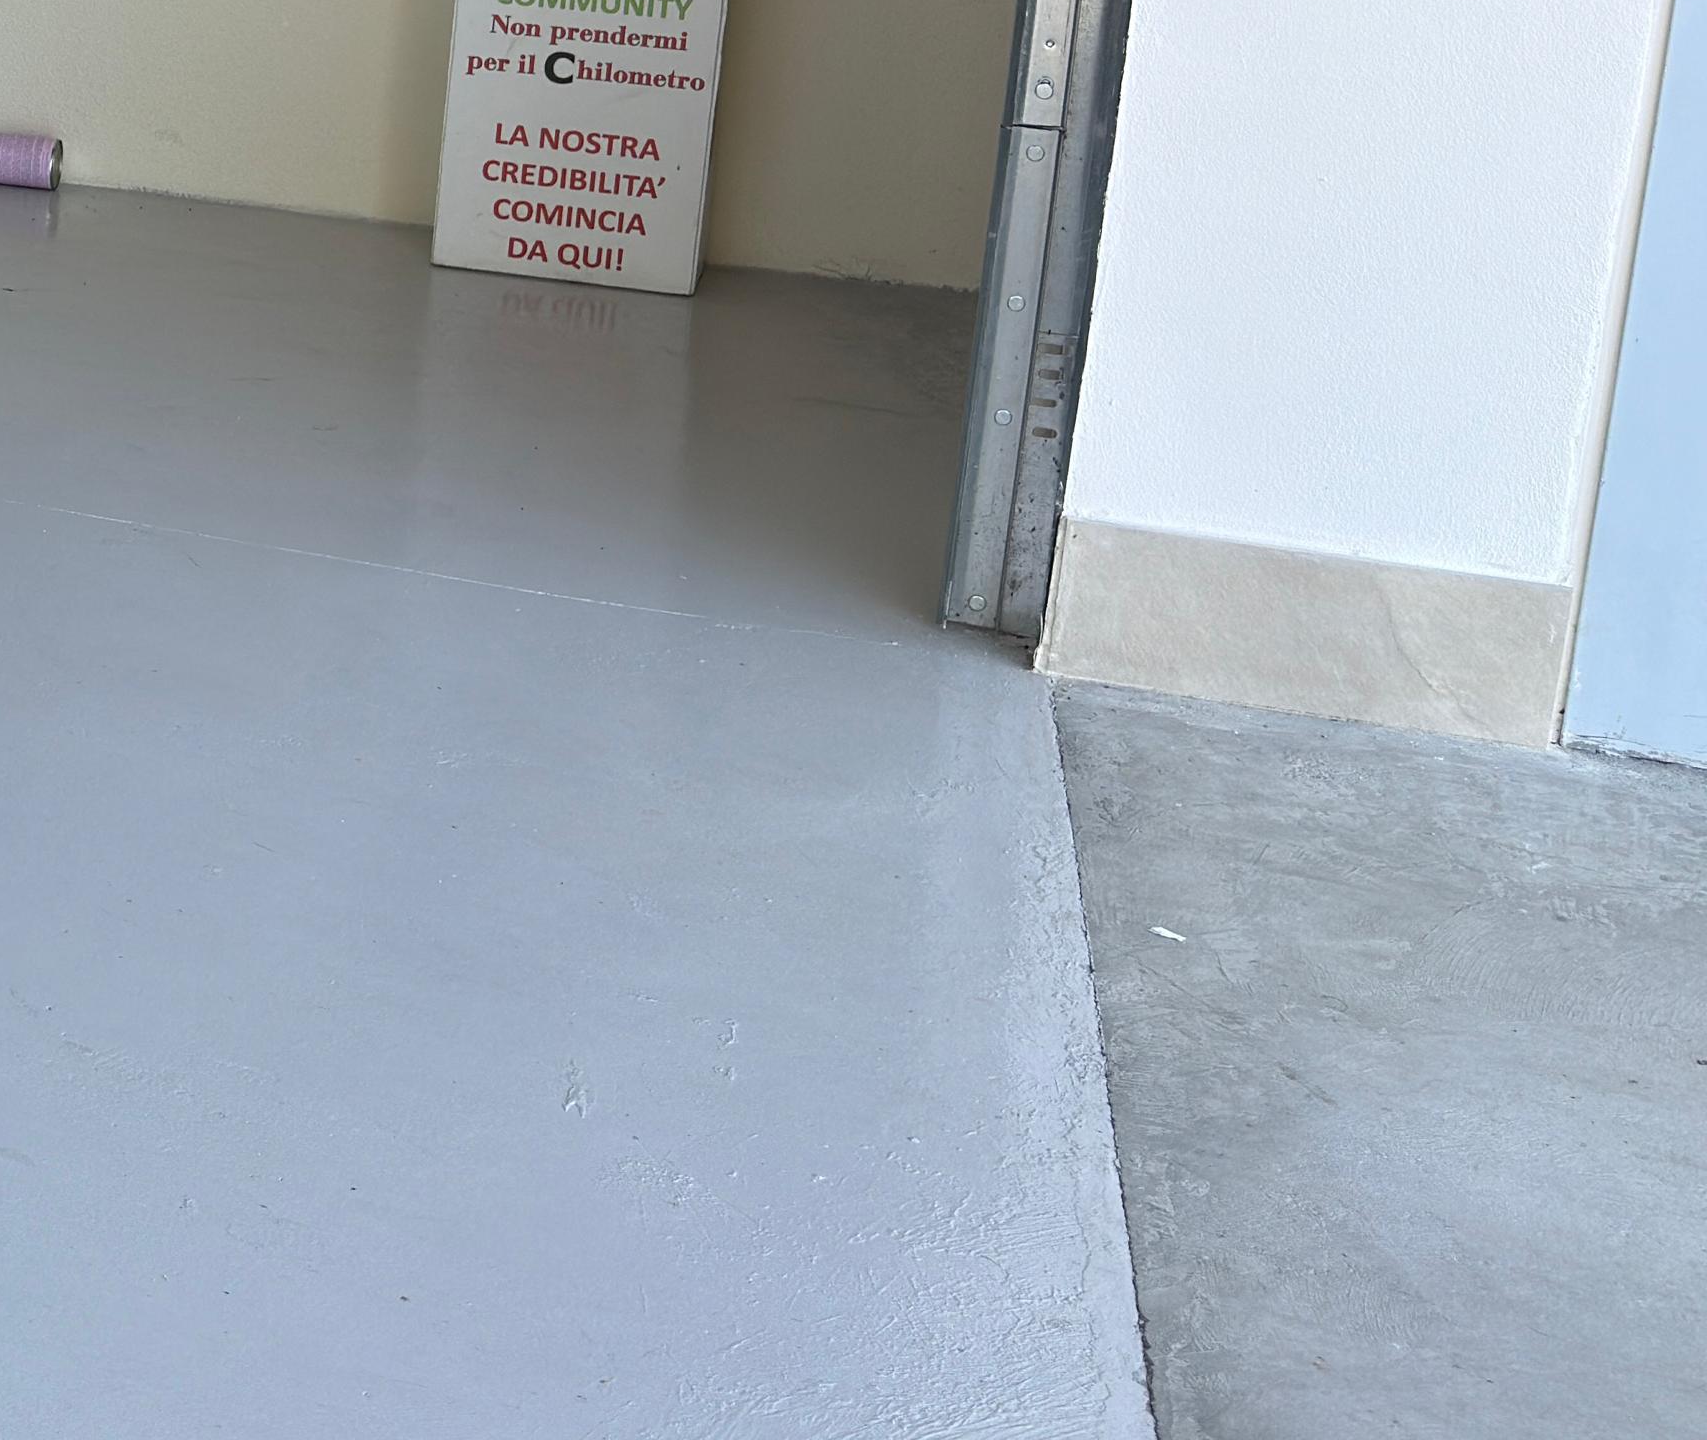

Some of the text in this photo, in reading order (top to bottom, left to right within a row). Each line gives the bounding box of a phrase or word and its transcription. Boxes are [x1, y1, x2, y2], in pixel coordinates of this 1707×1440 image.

[489, 14, 688, 51] Non prendermi
[465, 51, 706, 92] per il Chilometro
[495, 123, 660, 161] LA NOSTRA
[493, 198, 646, 236] COMINCIA
[507, 237, 624, 271] DA QUI!
